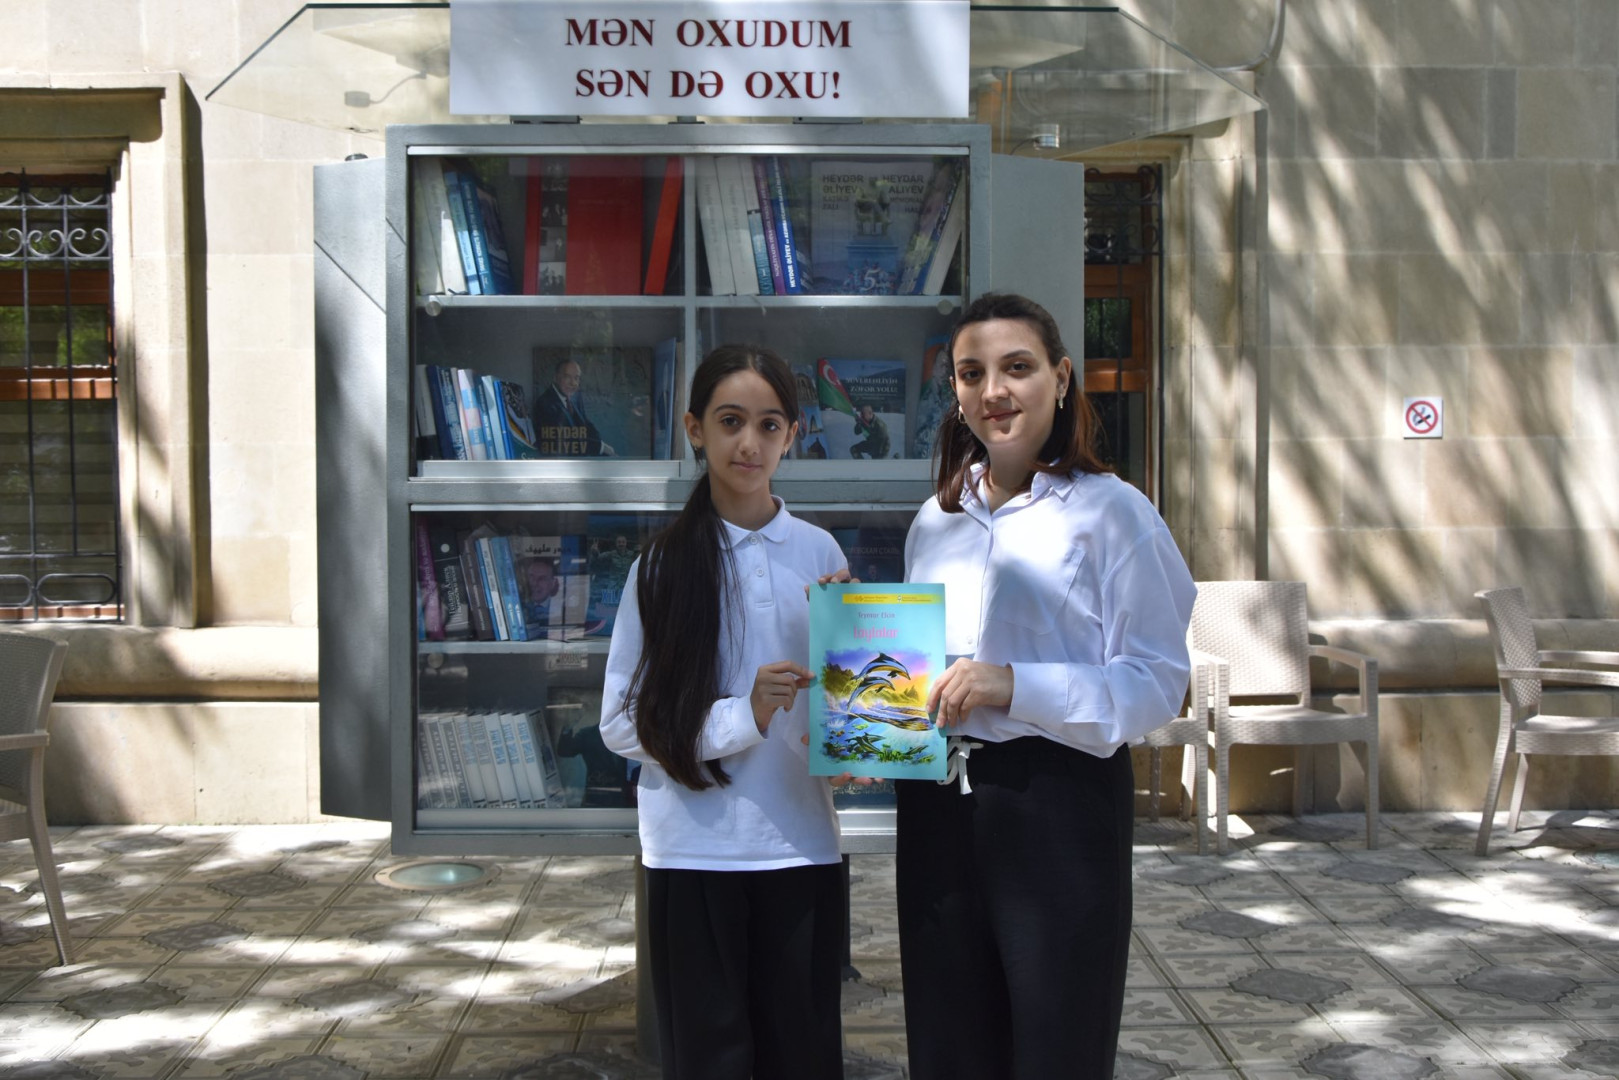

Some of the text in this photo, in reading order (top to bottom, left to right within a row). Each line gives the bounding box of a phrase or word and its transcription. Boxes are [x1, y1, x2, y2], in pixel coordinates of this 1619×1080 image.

[564, 18, 852, 48] MƏN OXUDUM
[575, 69, 841, 100] SƏN DƏ OXU!
[822, 174, 864, 184] HEYDƏR
[822, 184, 858, 194] ƏLİYEV
[783, 243, 793, 265] ƏLİYEV
[787, 264, 797, 288] HEYDƏR
[541, 426, 588, 439] HEYDƏR
[541, 440, 588, 454] ƏLİYEV
[853, 625, 899, 642] Laylalar
